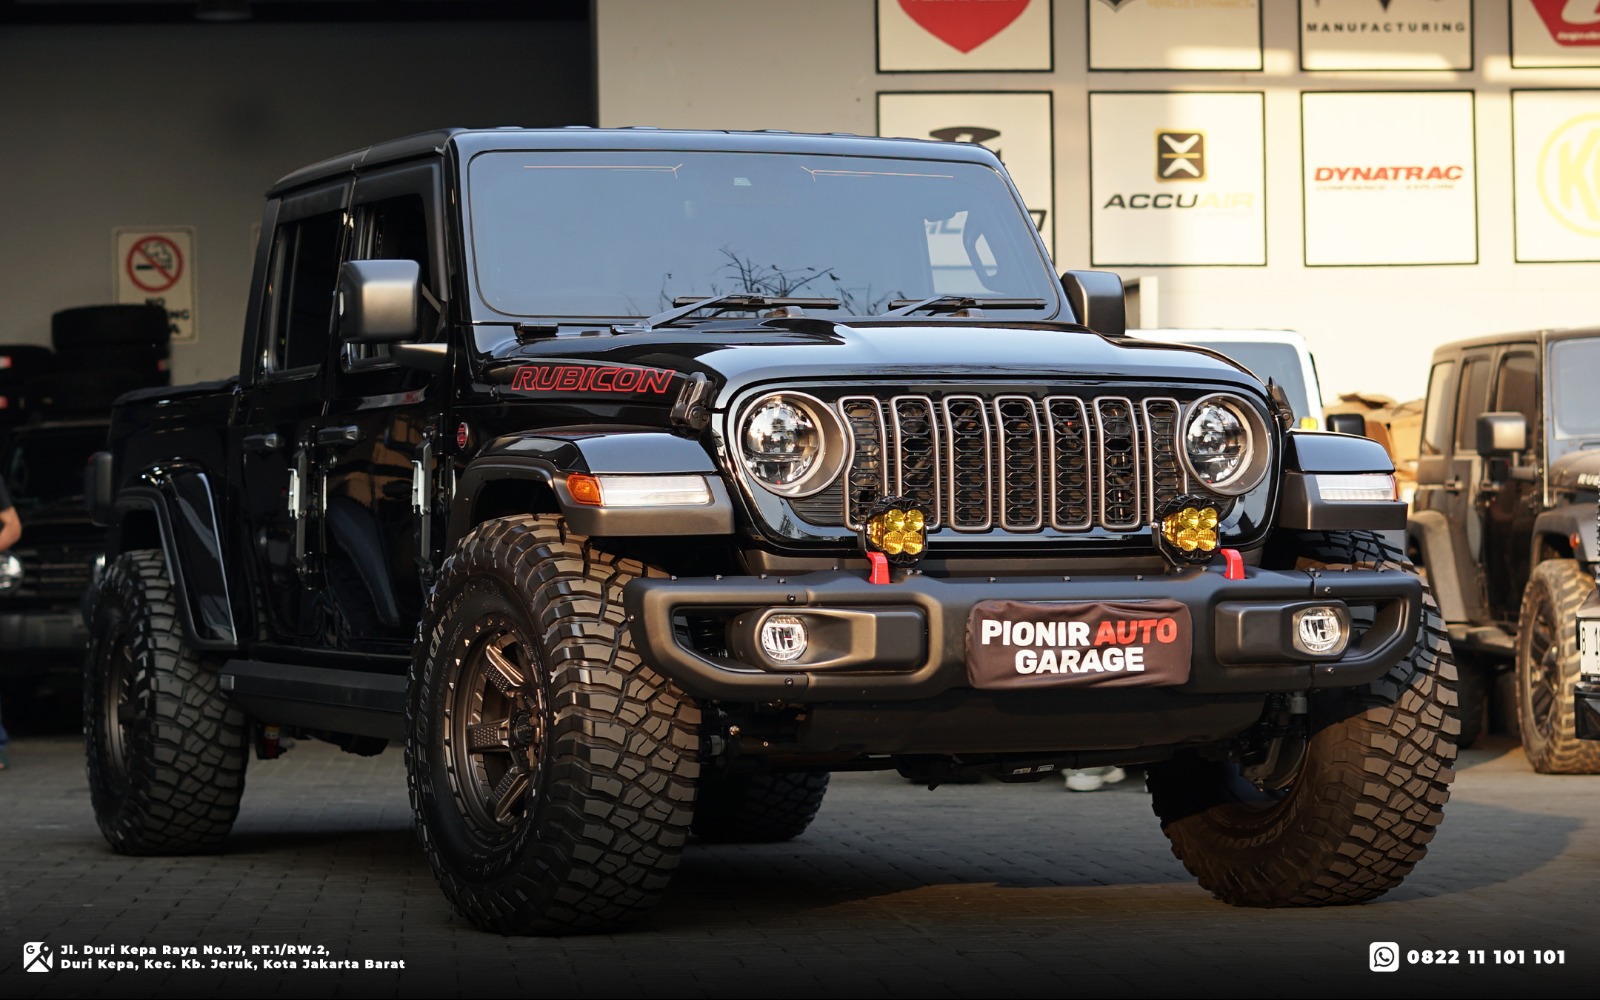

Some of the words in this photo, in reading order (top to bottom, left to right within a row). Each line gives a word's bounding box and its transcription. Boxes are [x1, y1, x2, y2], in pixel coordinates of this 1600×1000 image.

[1306, 22, 1466, 33] MANUFACTURING
[1314, 165, 1464, 181] DYNATRAC
[511, 365, 676, 394] RUBICON
[981, 619, 1091, 647] PIONIR
[1094, 617, 1178, 646] AUTO
[1014, 646, 1145, 674] GARAGE
